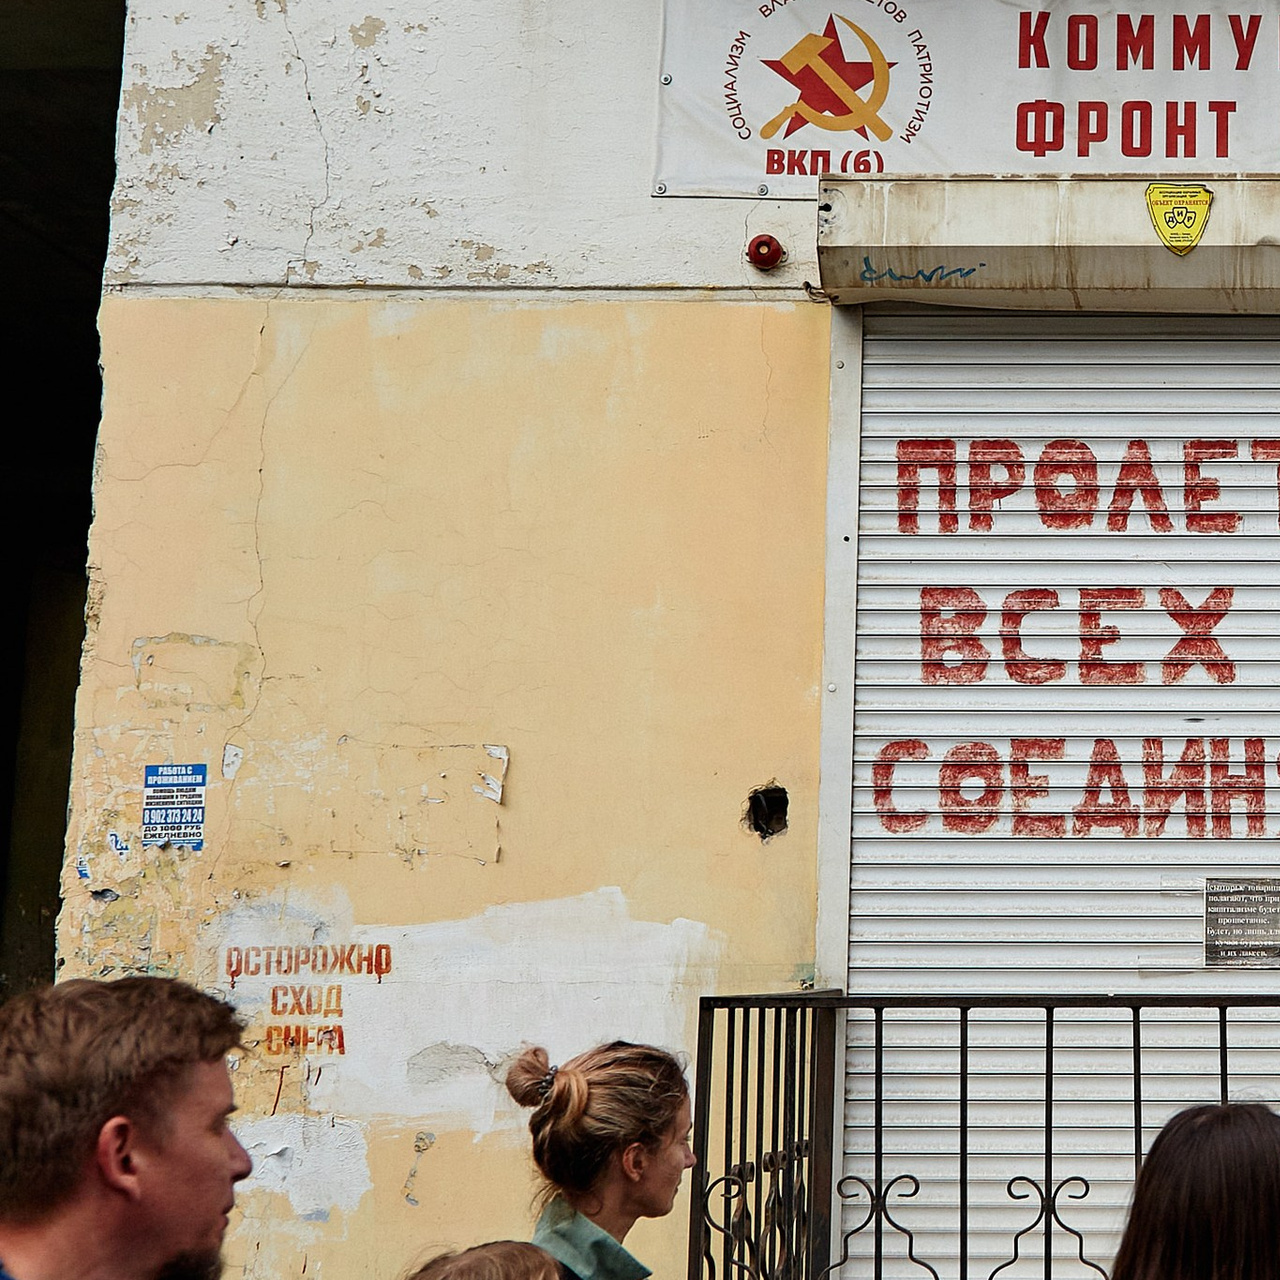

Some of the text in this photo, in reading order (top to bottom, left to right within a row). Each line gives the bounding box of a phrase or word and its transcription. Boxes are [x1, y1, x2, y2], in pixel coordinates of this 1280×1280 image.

[723, 29, 752, 140] СОЦИАЛИЗМ
[899, 29, 934, 144] ПАТРИОТИЗМ
[1015, 99, 1237, 159] ФРОНТ
[765, 149, 831, 175] ВКП
[919, 587, 1237, 685] ВСЕХ
[147, 775, 202, 785] ПРОЖИВАНИЕМ
[158, 766, 193, 775] РАБОТА С
[144, 808, 202, 824] 8 902 373 24 24
[1258, 905, 1280, 915] будет
[1265, 895, 1280, 904] при
[225, 944, 392, 978] ОСТОРОЖНО
[271, 984, 343, 1018] СХОД
[266, 1024, 345, 1056] СНЕГА
